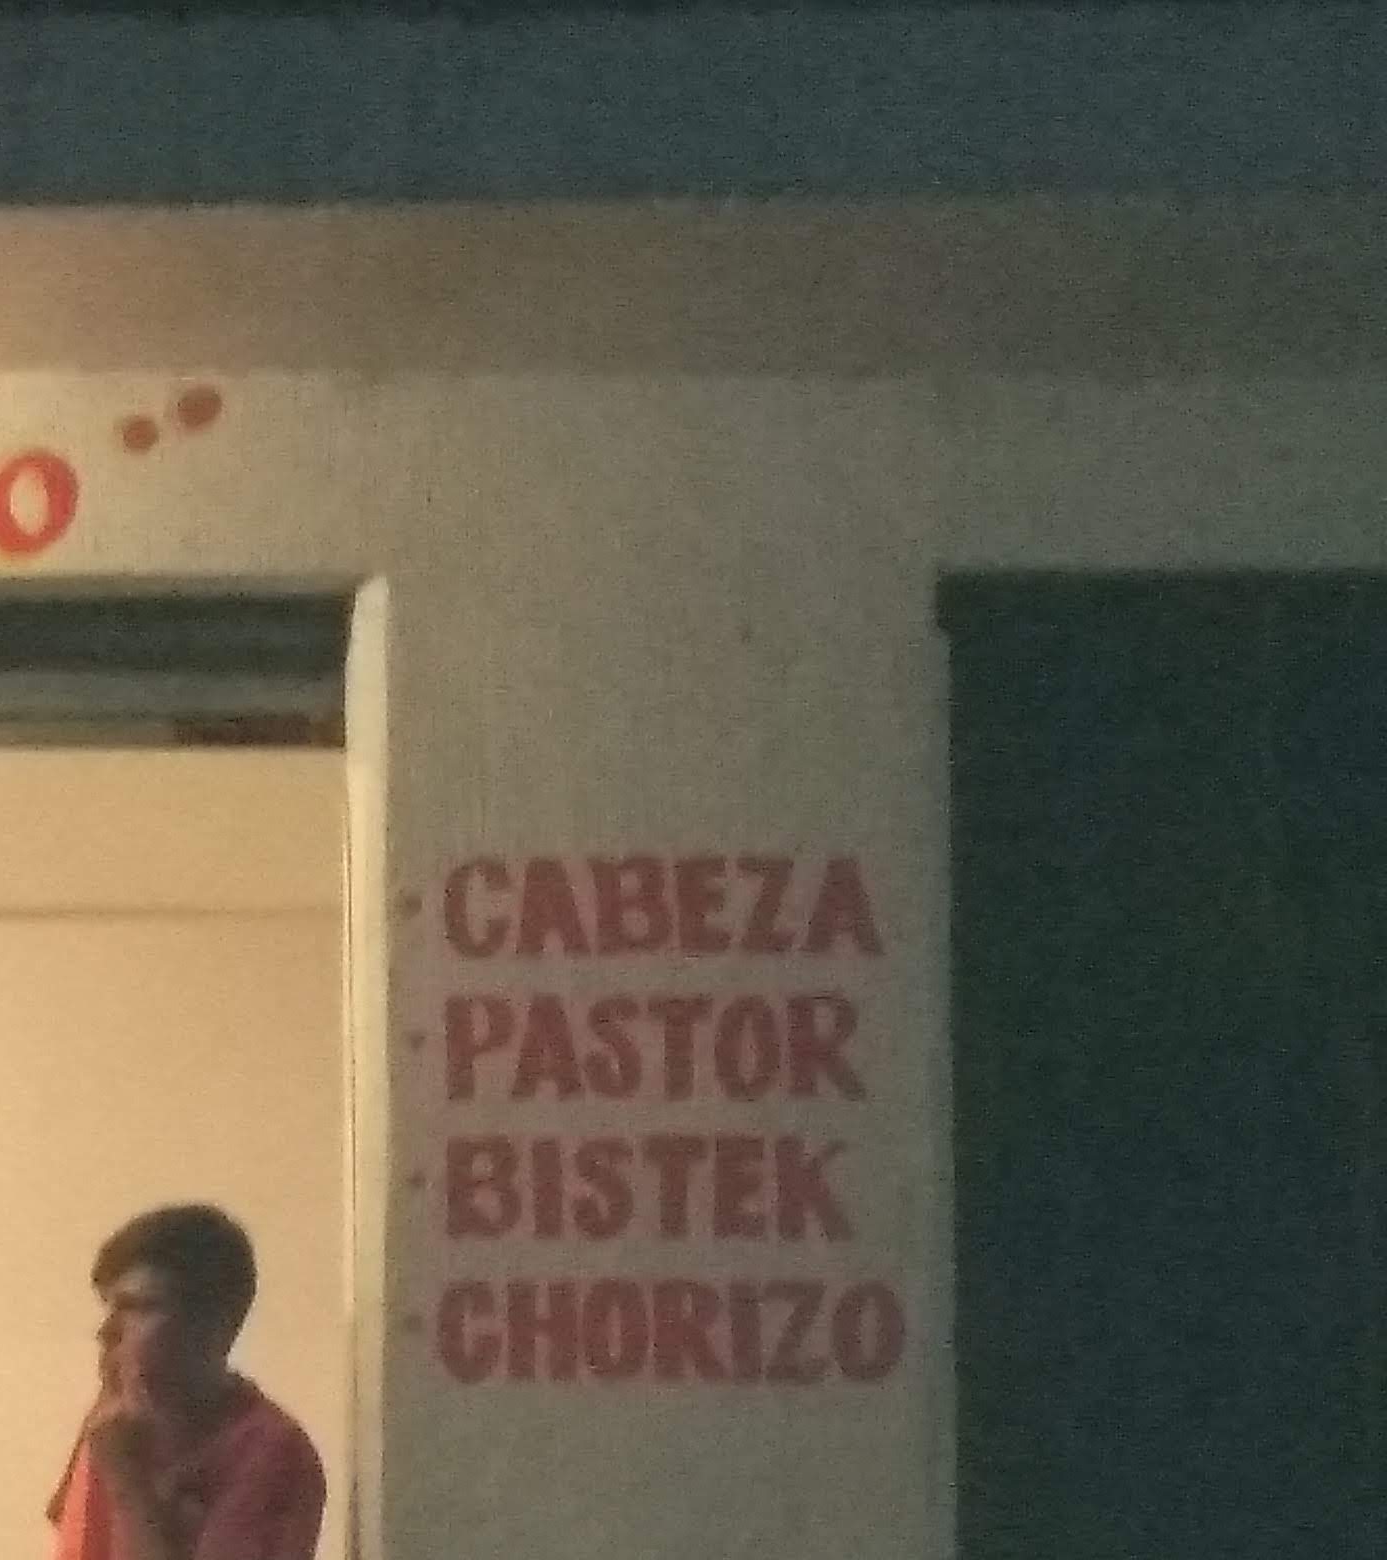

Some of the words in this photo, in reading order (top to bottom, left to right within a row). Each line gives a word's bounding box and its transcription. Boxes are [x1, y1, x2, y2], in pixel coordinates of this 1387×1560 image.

[441, 855, 886, 960] CABEZA
[442, 993, 871, 1102] PASTOR
[443, 1134, 855, 1242] BISTEK
[435, 1278, 909, 1385] CHORIZO
